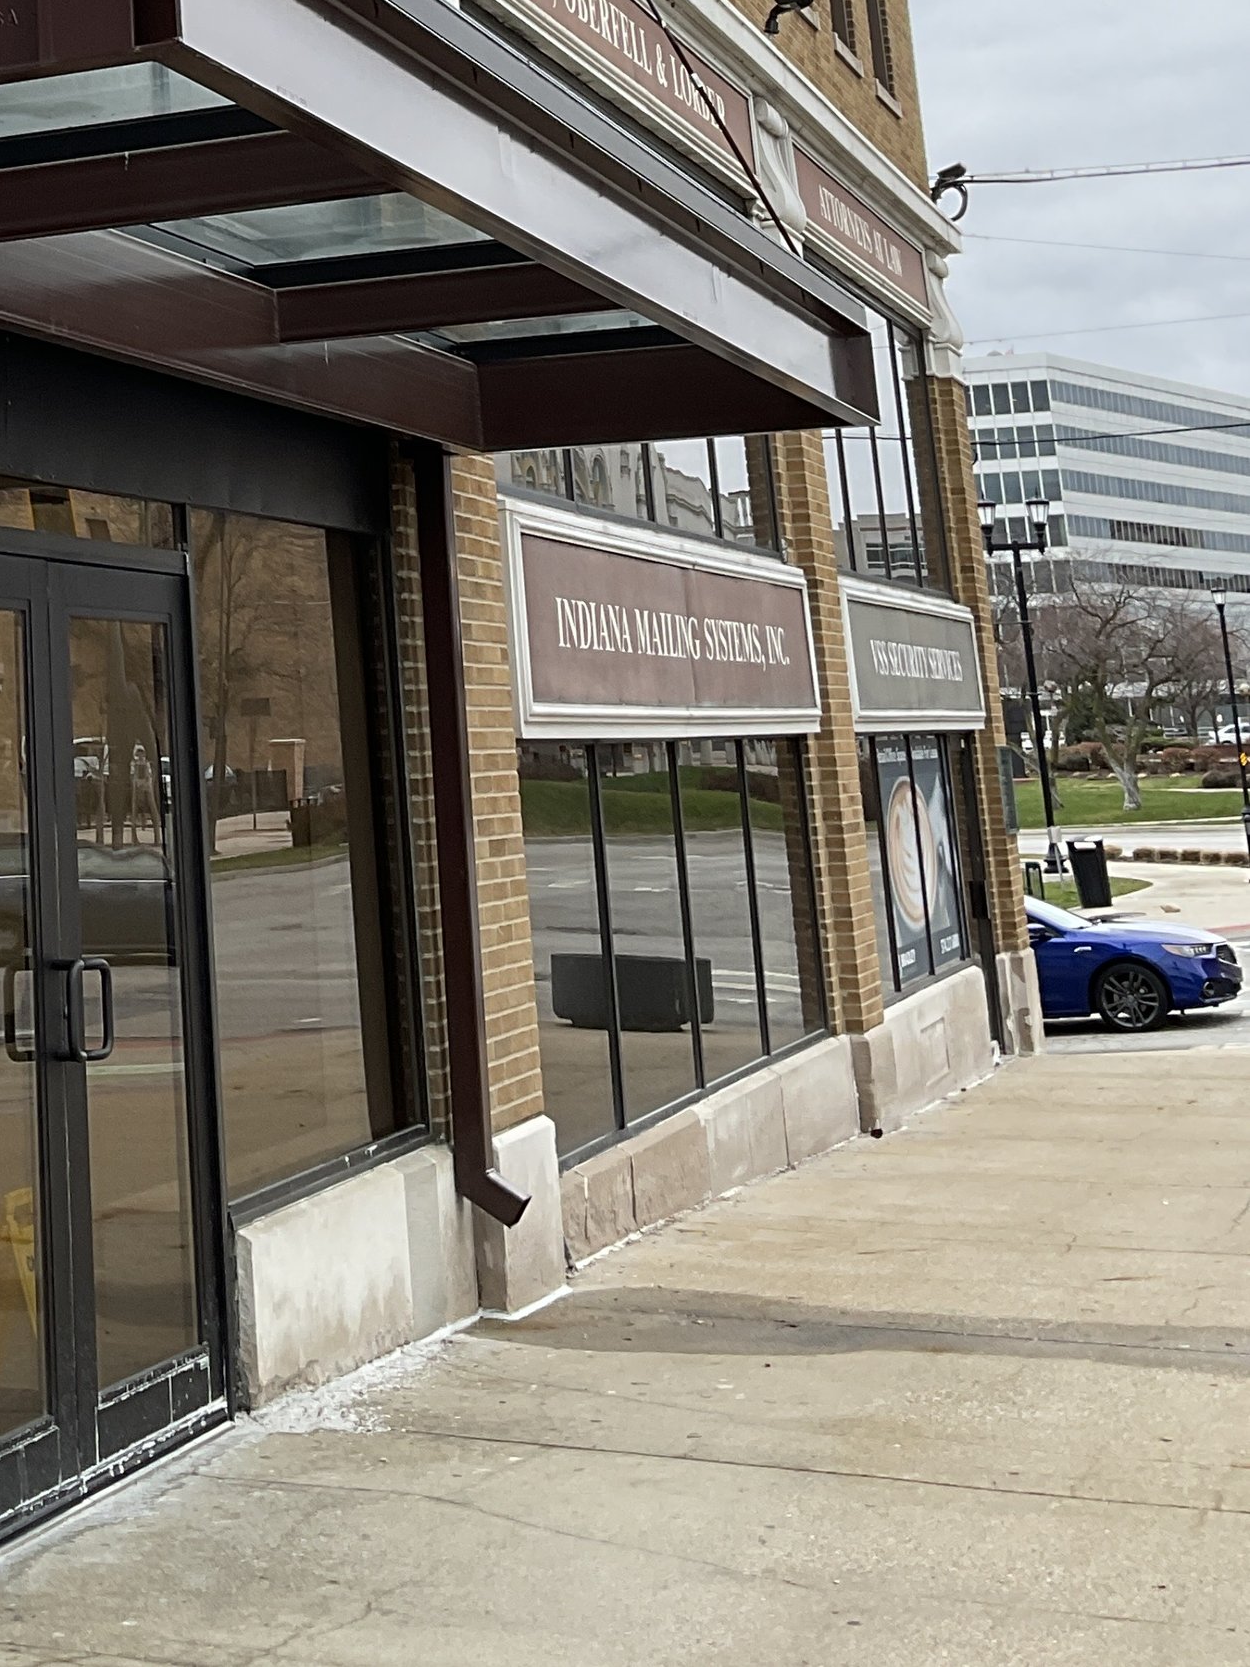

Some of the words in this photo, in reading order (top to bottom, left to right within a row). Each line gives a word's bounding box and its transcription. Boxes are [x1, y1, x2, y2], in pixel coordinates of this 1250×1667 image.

[656, 43, 668, 88] &
[819, 184, 873, 254] ATTORNEYS
[884, 238, 903, 277] LAW
[555, 597, 633, 654] INDIANA
[634, 608, 701, 661] MAILING
[703, 617, 767, 671] SYSTEMS,
[765, 625, 790, 666] INC.
[887, 642, 929, 678] SECURITY
[927, 647, 963, 681] SERVICES
